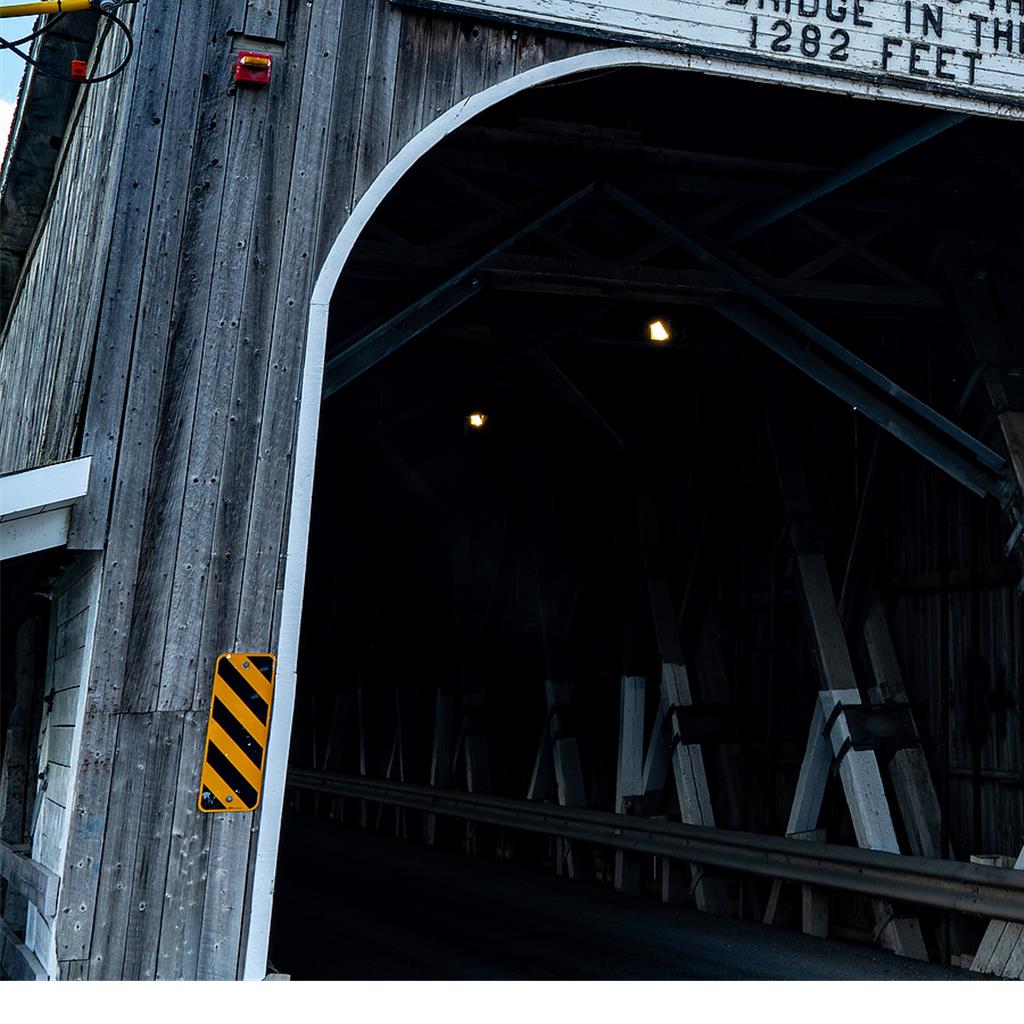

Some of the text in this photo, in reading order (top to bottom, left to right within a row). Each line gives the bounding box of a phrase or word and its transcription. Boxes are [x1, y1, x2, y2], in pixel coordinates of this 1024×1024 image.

[904, 1, 943, 38] IN
[749, 16, 983, 84] 1282 FEET
